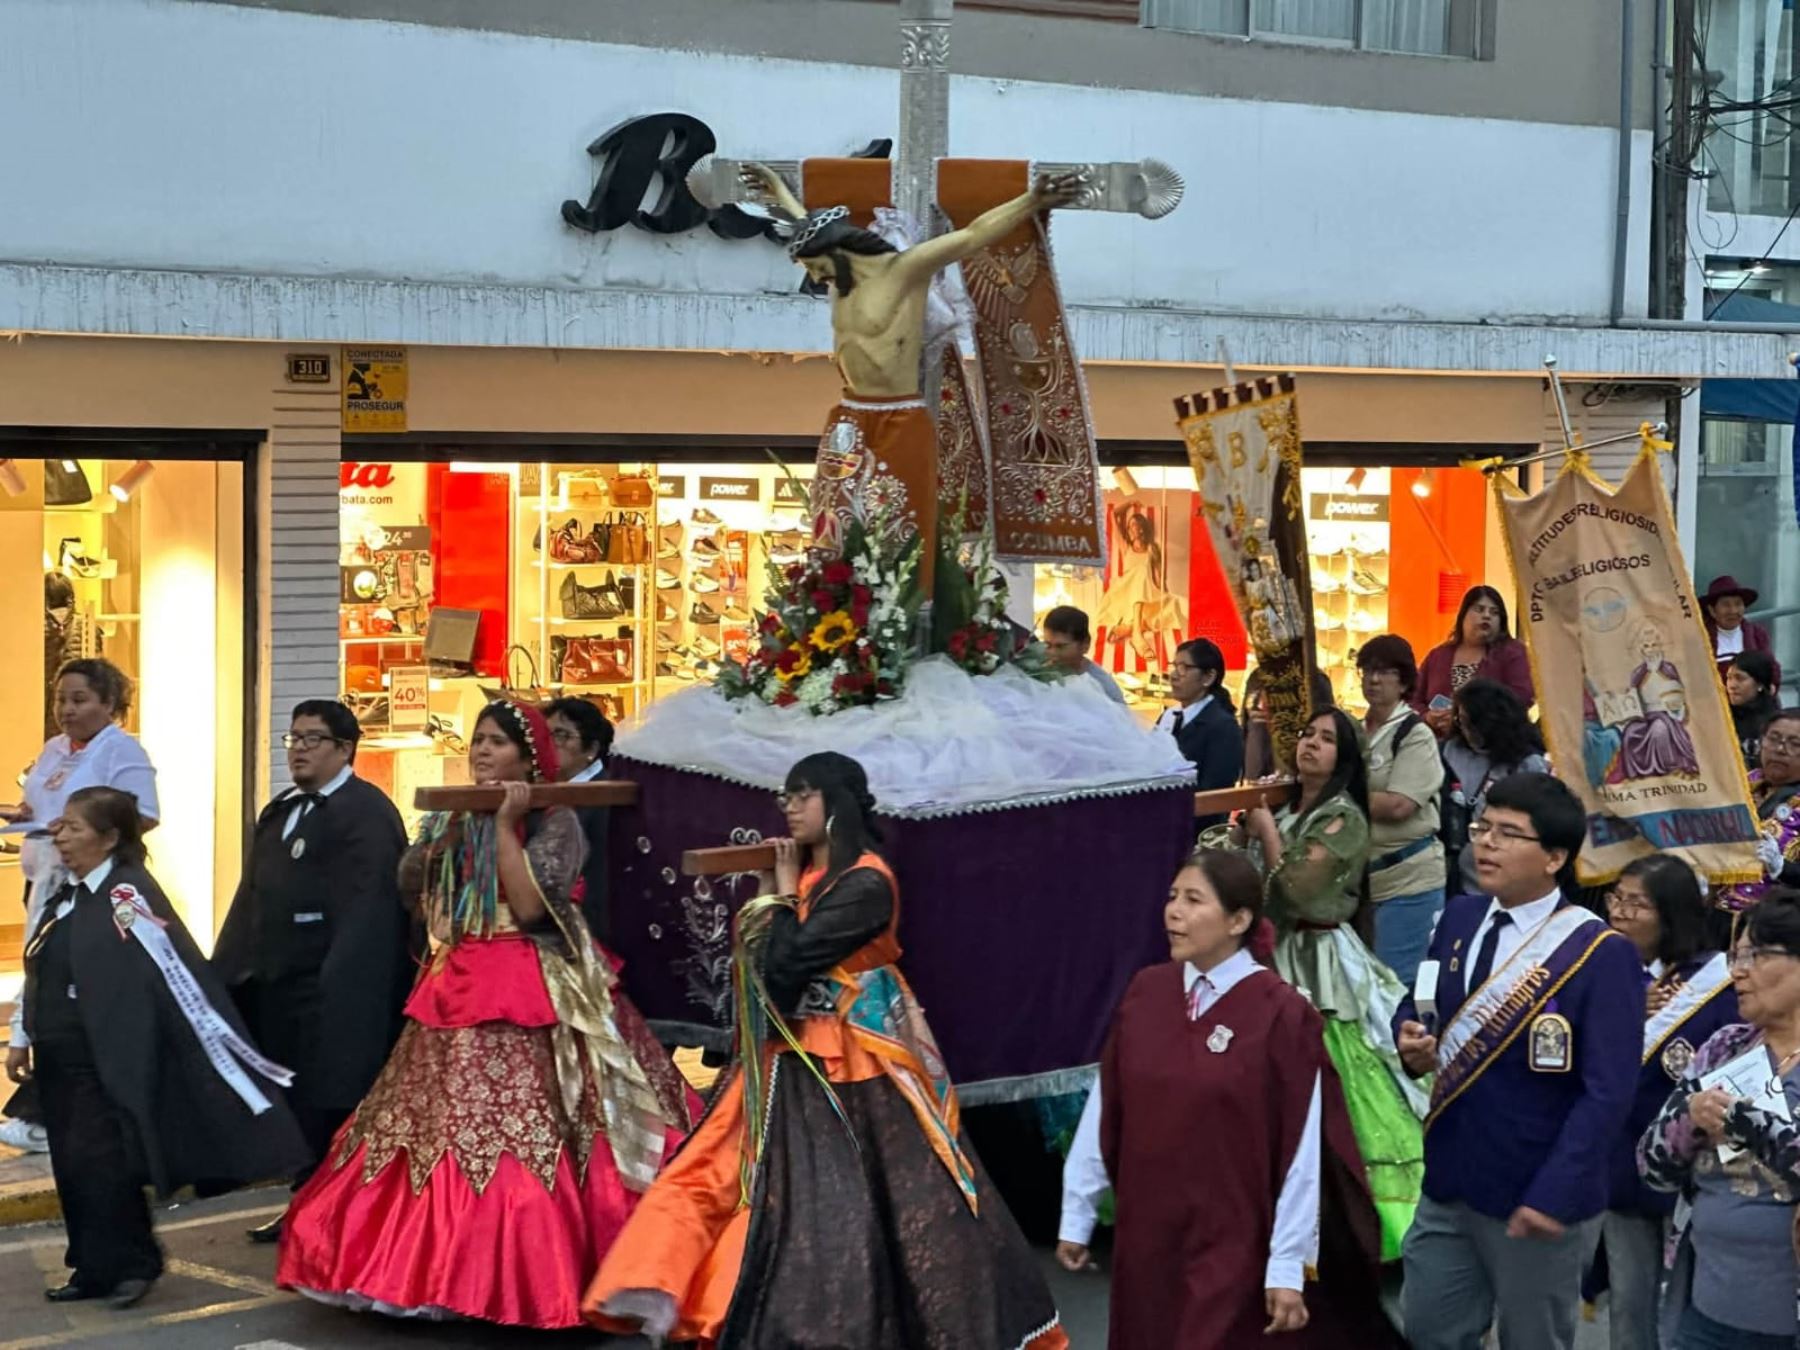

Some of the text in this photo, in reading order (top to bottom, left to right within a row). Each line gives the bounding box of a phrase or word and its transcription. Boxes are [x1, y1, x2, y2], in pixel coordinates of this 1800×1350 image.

[298, 360, 323, 374] 310
[347, 401, 404, 411] PROSEGUR
[710, 484, 750, 497] power
[341, 495, 393, 505] bata.com
[1324, 502, 1379, 516] power
[394, 686, 425, 702] 40%
[1639, 782, 1709, 799] TRINIDAD
[1471, 961, 1551, 1037] Milagros
